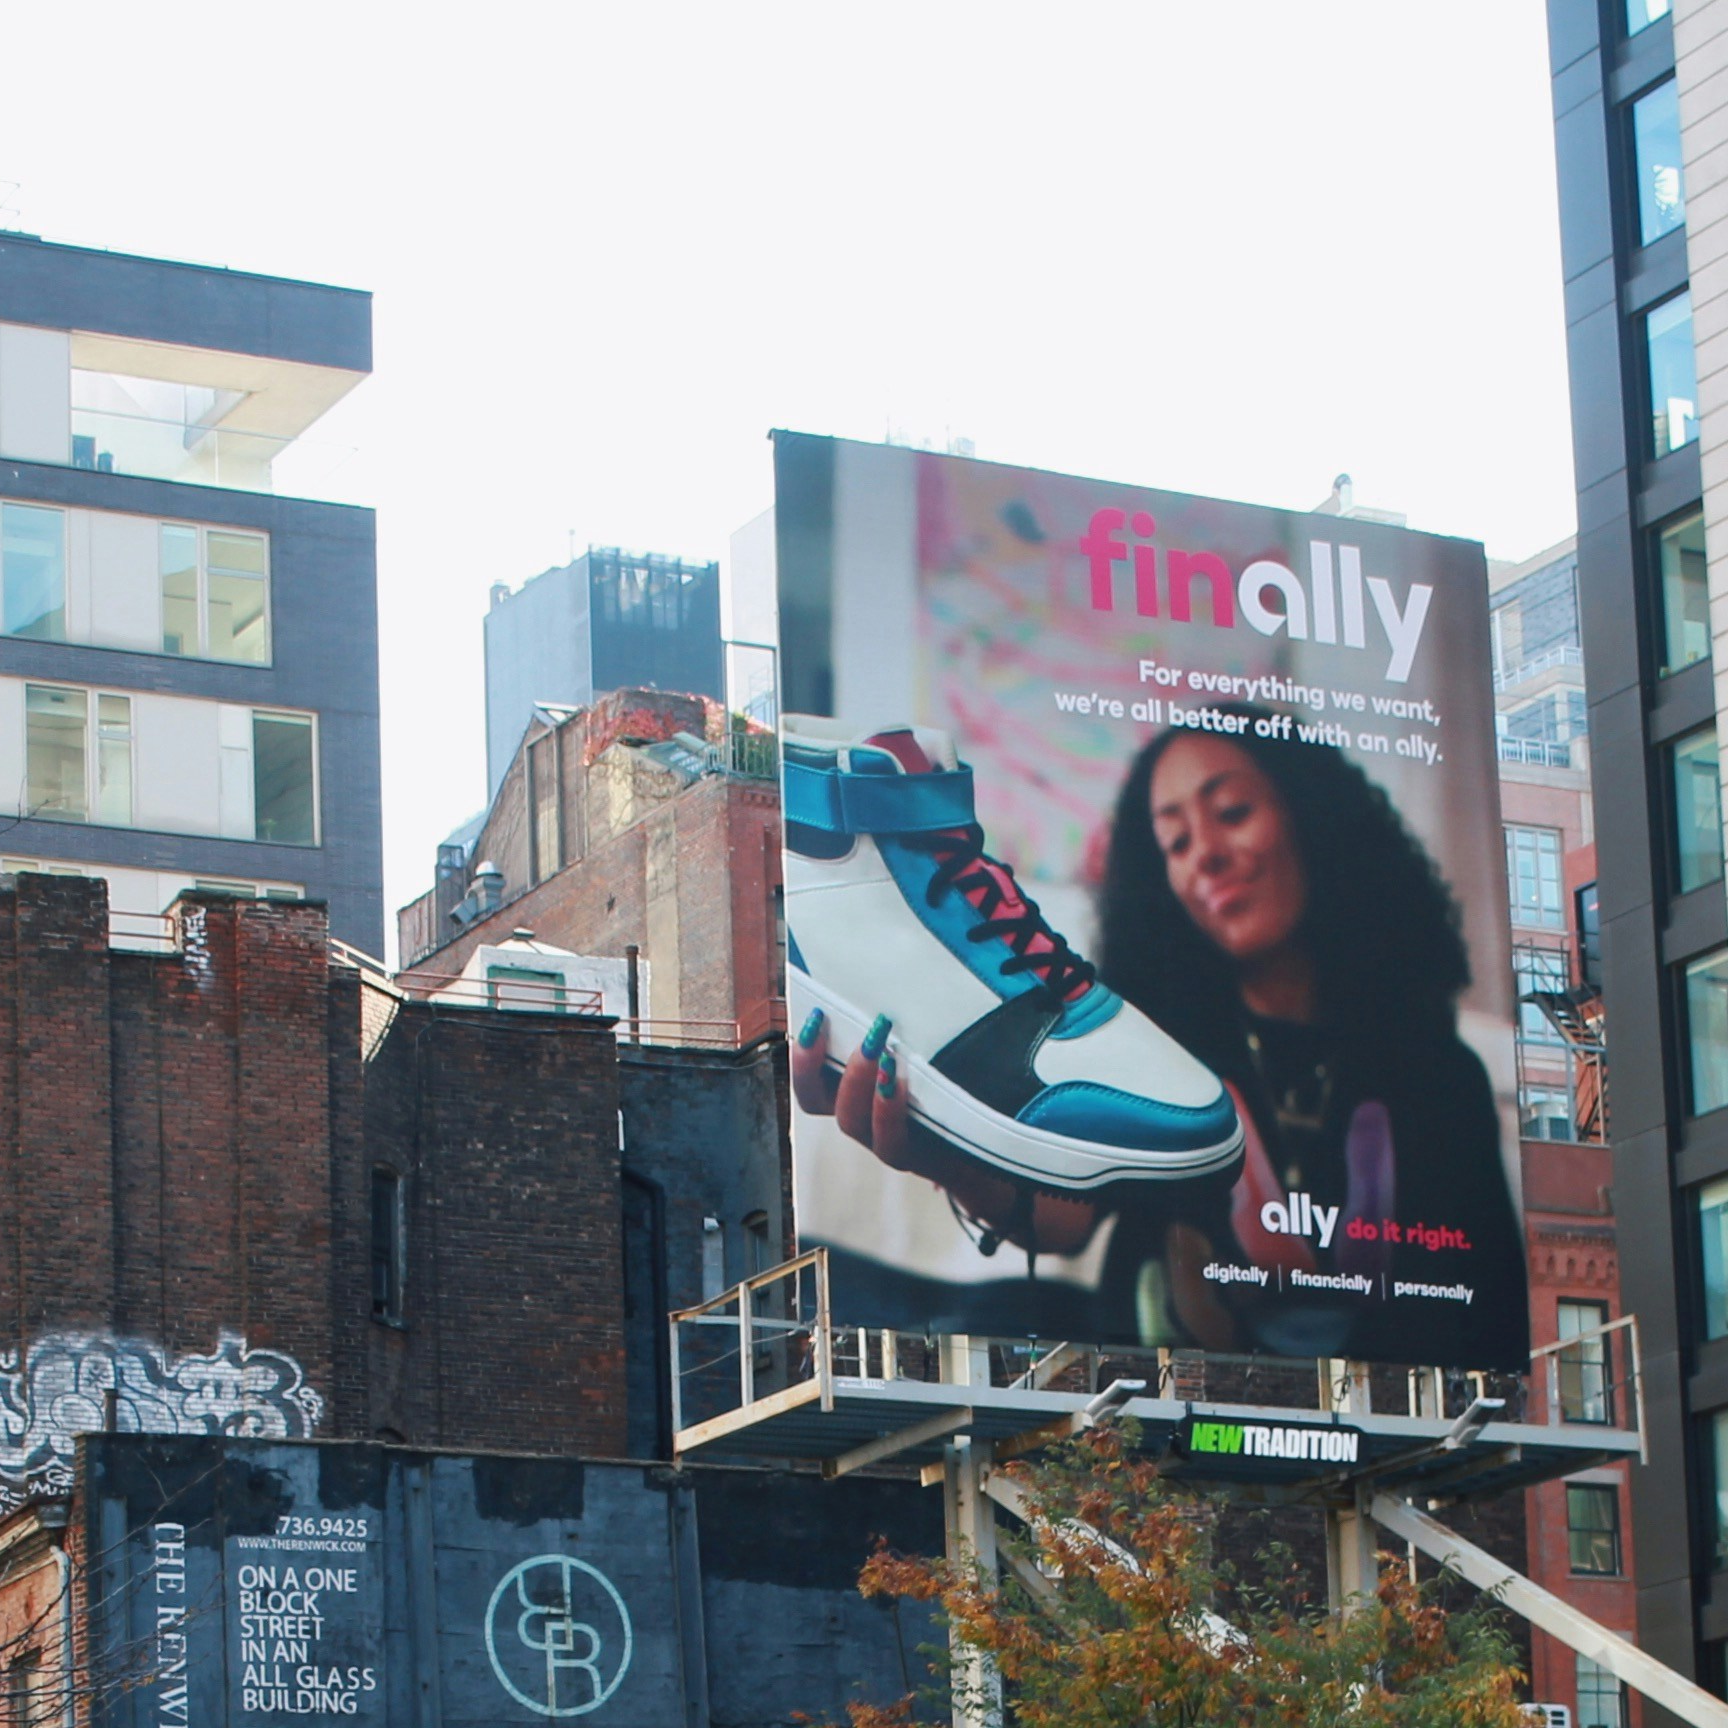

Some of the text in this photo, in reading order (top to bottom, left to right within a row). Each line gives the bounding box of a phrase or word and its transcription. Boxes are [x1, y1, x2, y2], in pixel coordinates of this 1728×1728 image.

[1079, 507, 1434, 683] finally
[1139, 660, 1441, 727] For everything we want,
[1055, 692, 1444, 767] we're all better off with an ally.
[1260, 1192, 1339, 1248] ally
[1346, 1217, 1472, 1251] do it right.
[1203, 1263, 1473, 1304] digitally financially personally
[155, 1522, 185, 1593] THE
[238, 1538, 366, 1552] WWW.THERENWICK.COM
[238, 1565, 357, 1592] ON A ONE
[240, 1591, 319, 1615] BLOCK
[240, 1616, 324, 1640] STREET
[242, 1641, 307, 1663] IN AN
[242, 1665, 376, 1690] ALL GLASS
[243, 1689, 357, 1714] BUILDING
